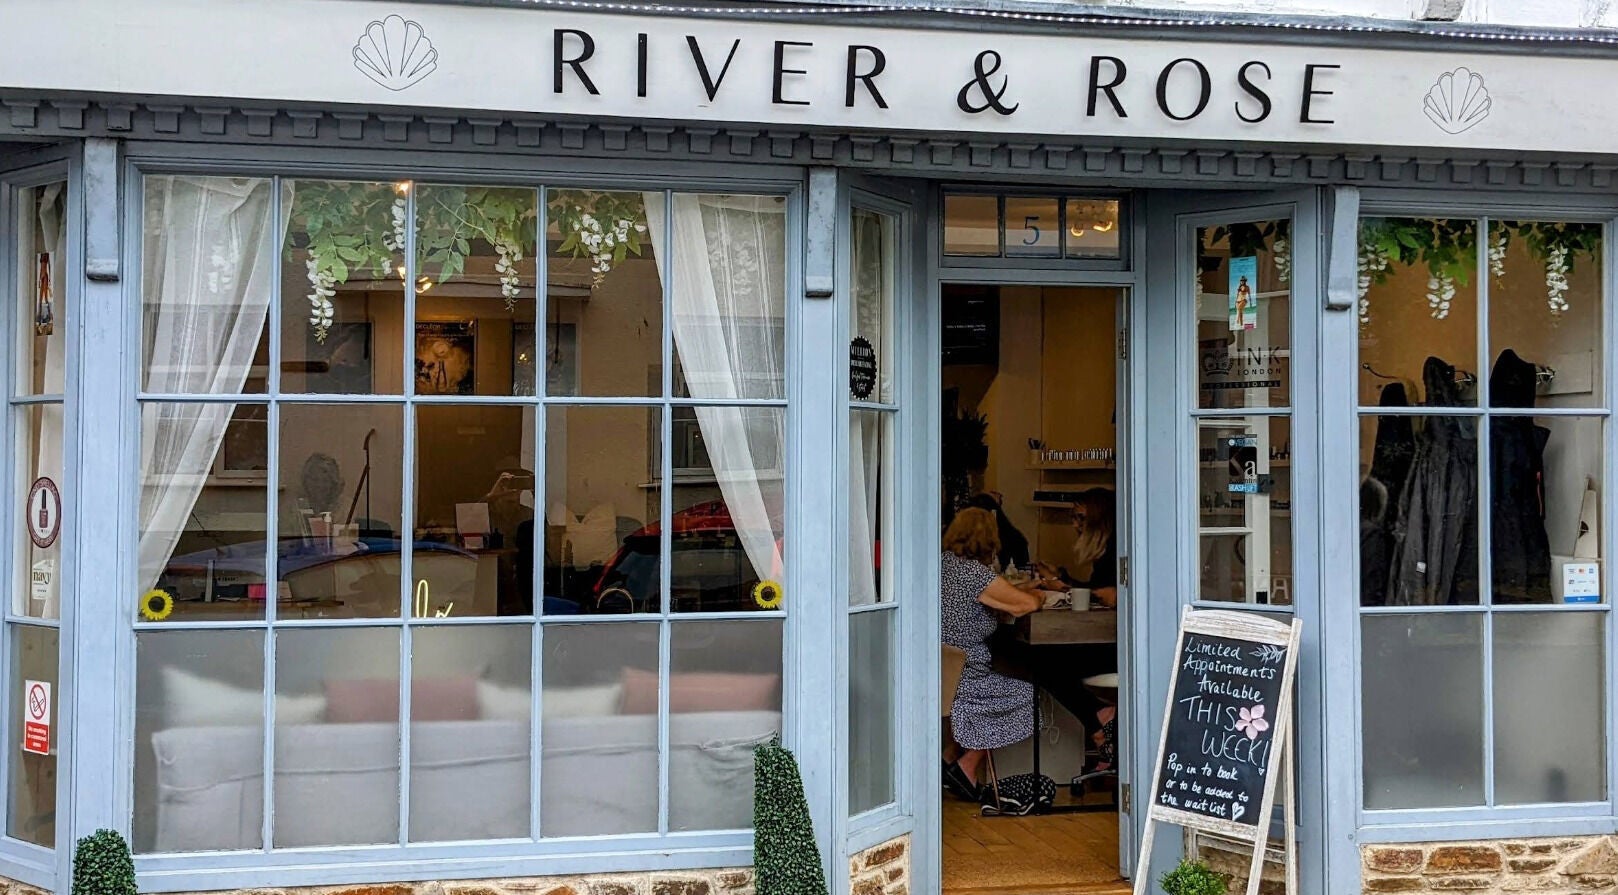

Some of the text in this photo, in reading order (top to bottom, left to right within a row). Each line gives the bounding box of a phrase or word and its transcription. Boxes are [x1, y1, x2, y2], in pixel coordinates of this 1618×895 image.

[553, 28, 1342, 125] RIVER & ROSE
[1022, 215, 1040, 245] 5
[1185, 636, 1242, 660] Limited
[1183, 654, 1277, 680] Appointments
[1197, 673, 1264, 703] Available
[1179, 695, 1237, 731] THIS
[1167, 752, 1239, 781] Pop in to book
[1160, 791, 1179, 806] the
[1165, 779, 1249, 803] or to be added to
